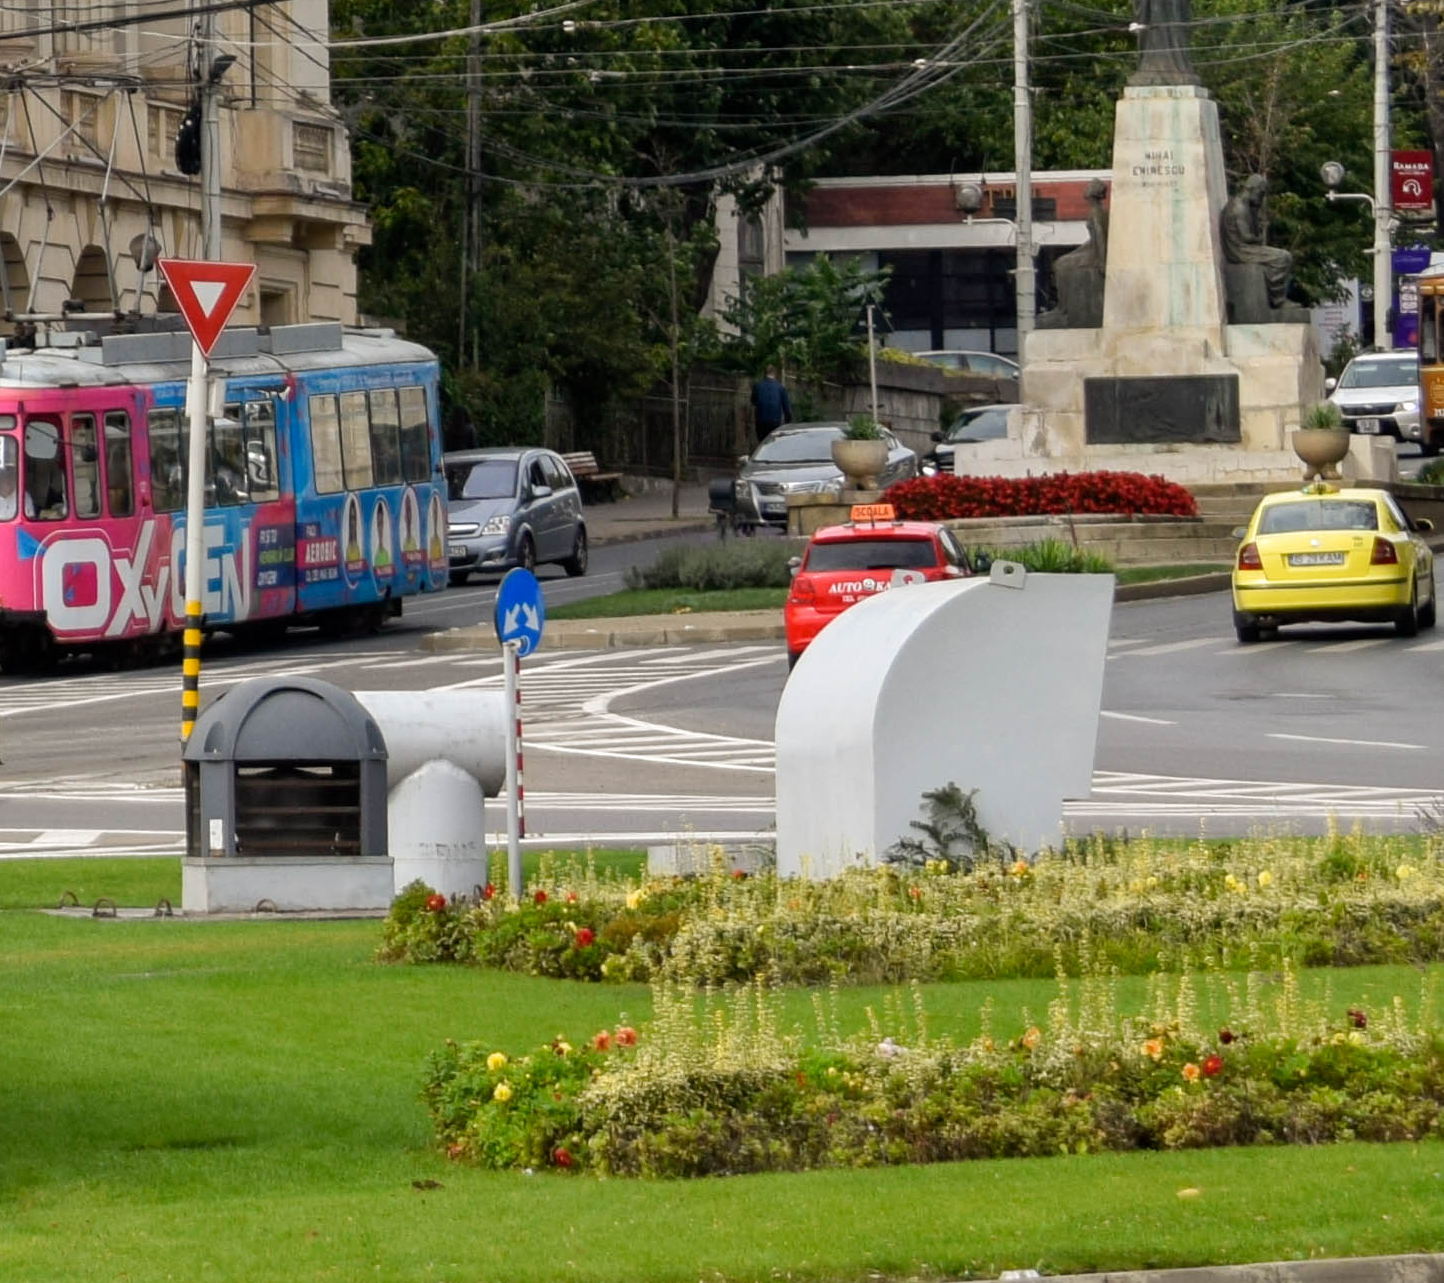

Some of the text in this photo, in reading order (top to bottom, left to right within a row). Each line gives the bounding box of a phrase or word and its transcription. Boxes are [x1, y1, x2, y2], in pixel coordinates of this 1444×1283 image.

[1144, 150, 1174, 161] MIHAI
[1393, 161, 1429, 170] RAMADA
[305, 540, 337, 564] AEROBIC
[829, 582, 863, 593] AUTO
